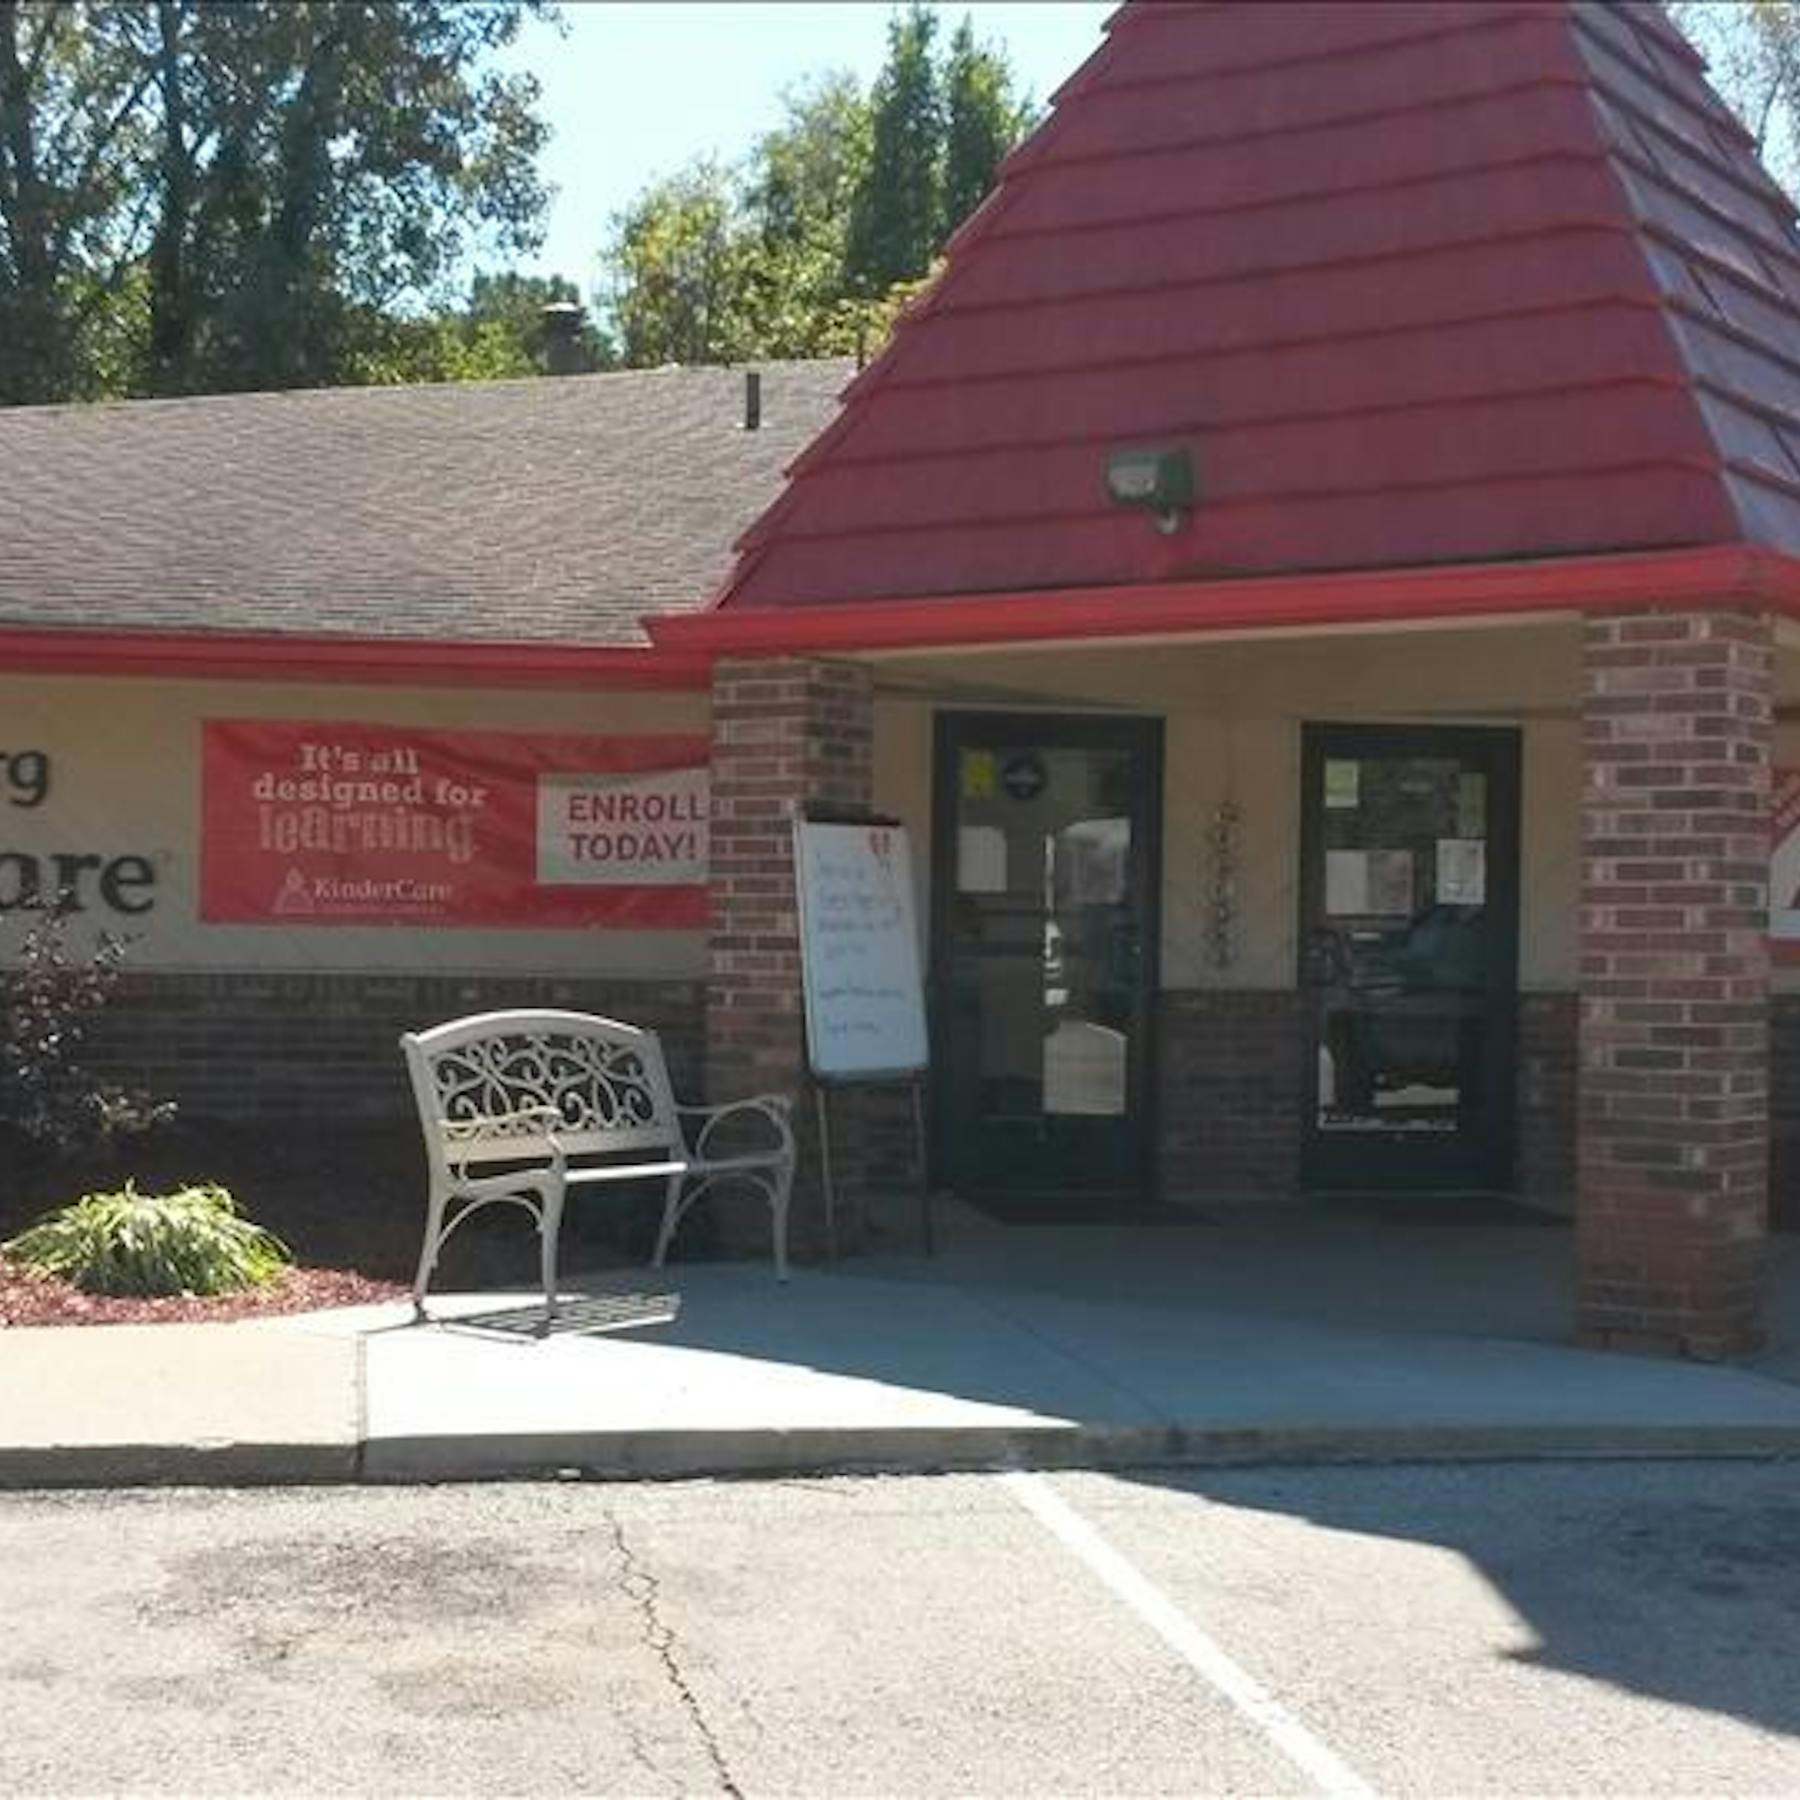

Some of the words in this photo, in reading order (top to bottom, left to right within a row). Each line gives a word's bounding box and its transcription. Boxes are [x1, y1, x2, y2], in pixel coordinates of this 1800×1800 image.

[300, 744, 361, 772] It's
[369, 748, 420, 775] all
[0, 751, 48, 807] g
[253, 773, 424, 808] designed
[434, 780, 488, 805] for
[568, 794, 706, 822] ENROLL
[568, 832, 697, 861] TODAY!
[314, 878, 454, 901] KinderCare
